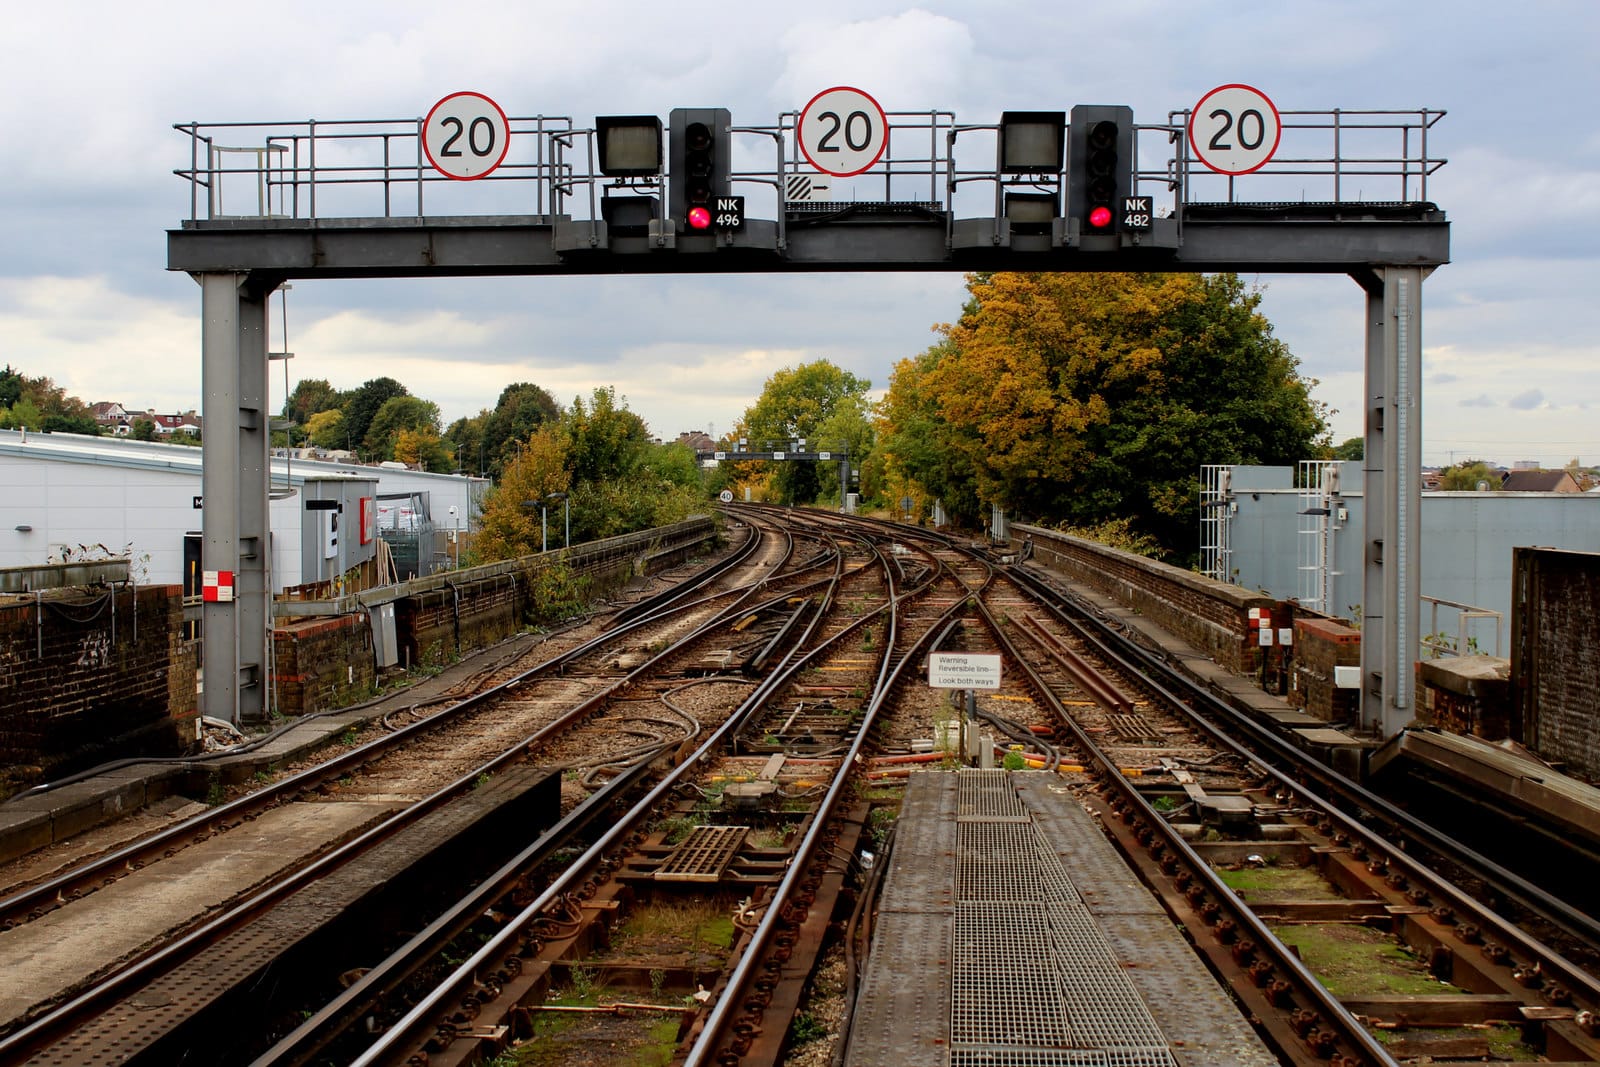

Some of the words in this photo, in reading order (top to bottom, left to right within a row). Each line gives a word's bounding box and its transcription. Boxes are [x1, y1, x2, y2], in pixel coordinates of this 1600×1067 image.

[818, 111, 872, 152] 20
[1209, 109, 1264, 150] 20
[441, 117, 495, 157] 20
[717, 199, 738, 211] NK
[1125, 199, 1147, 211] NK
[716, 214, 740, 226] 496
[1124, 214, 1148, 226] 482
[721, 491, 732, 501] 40
